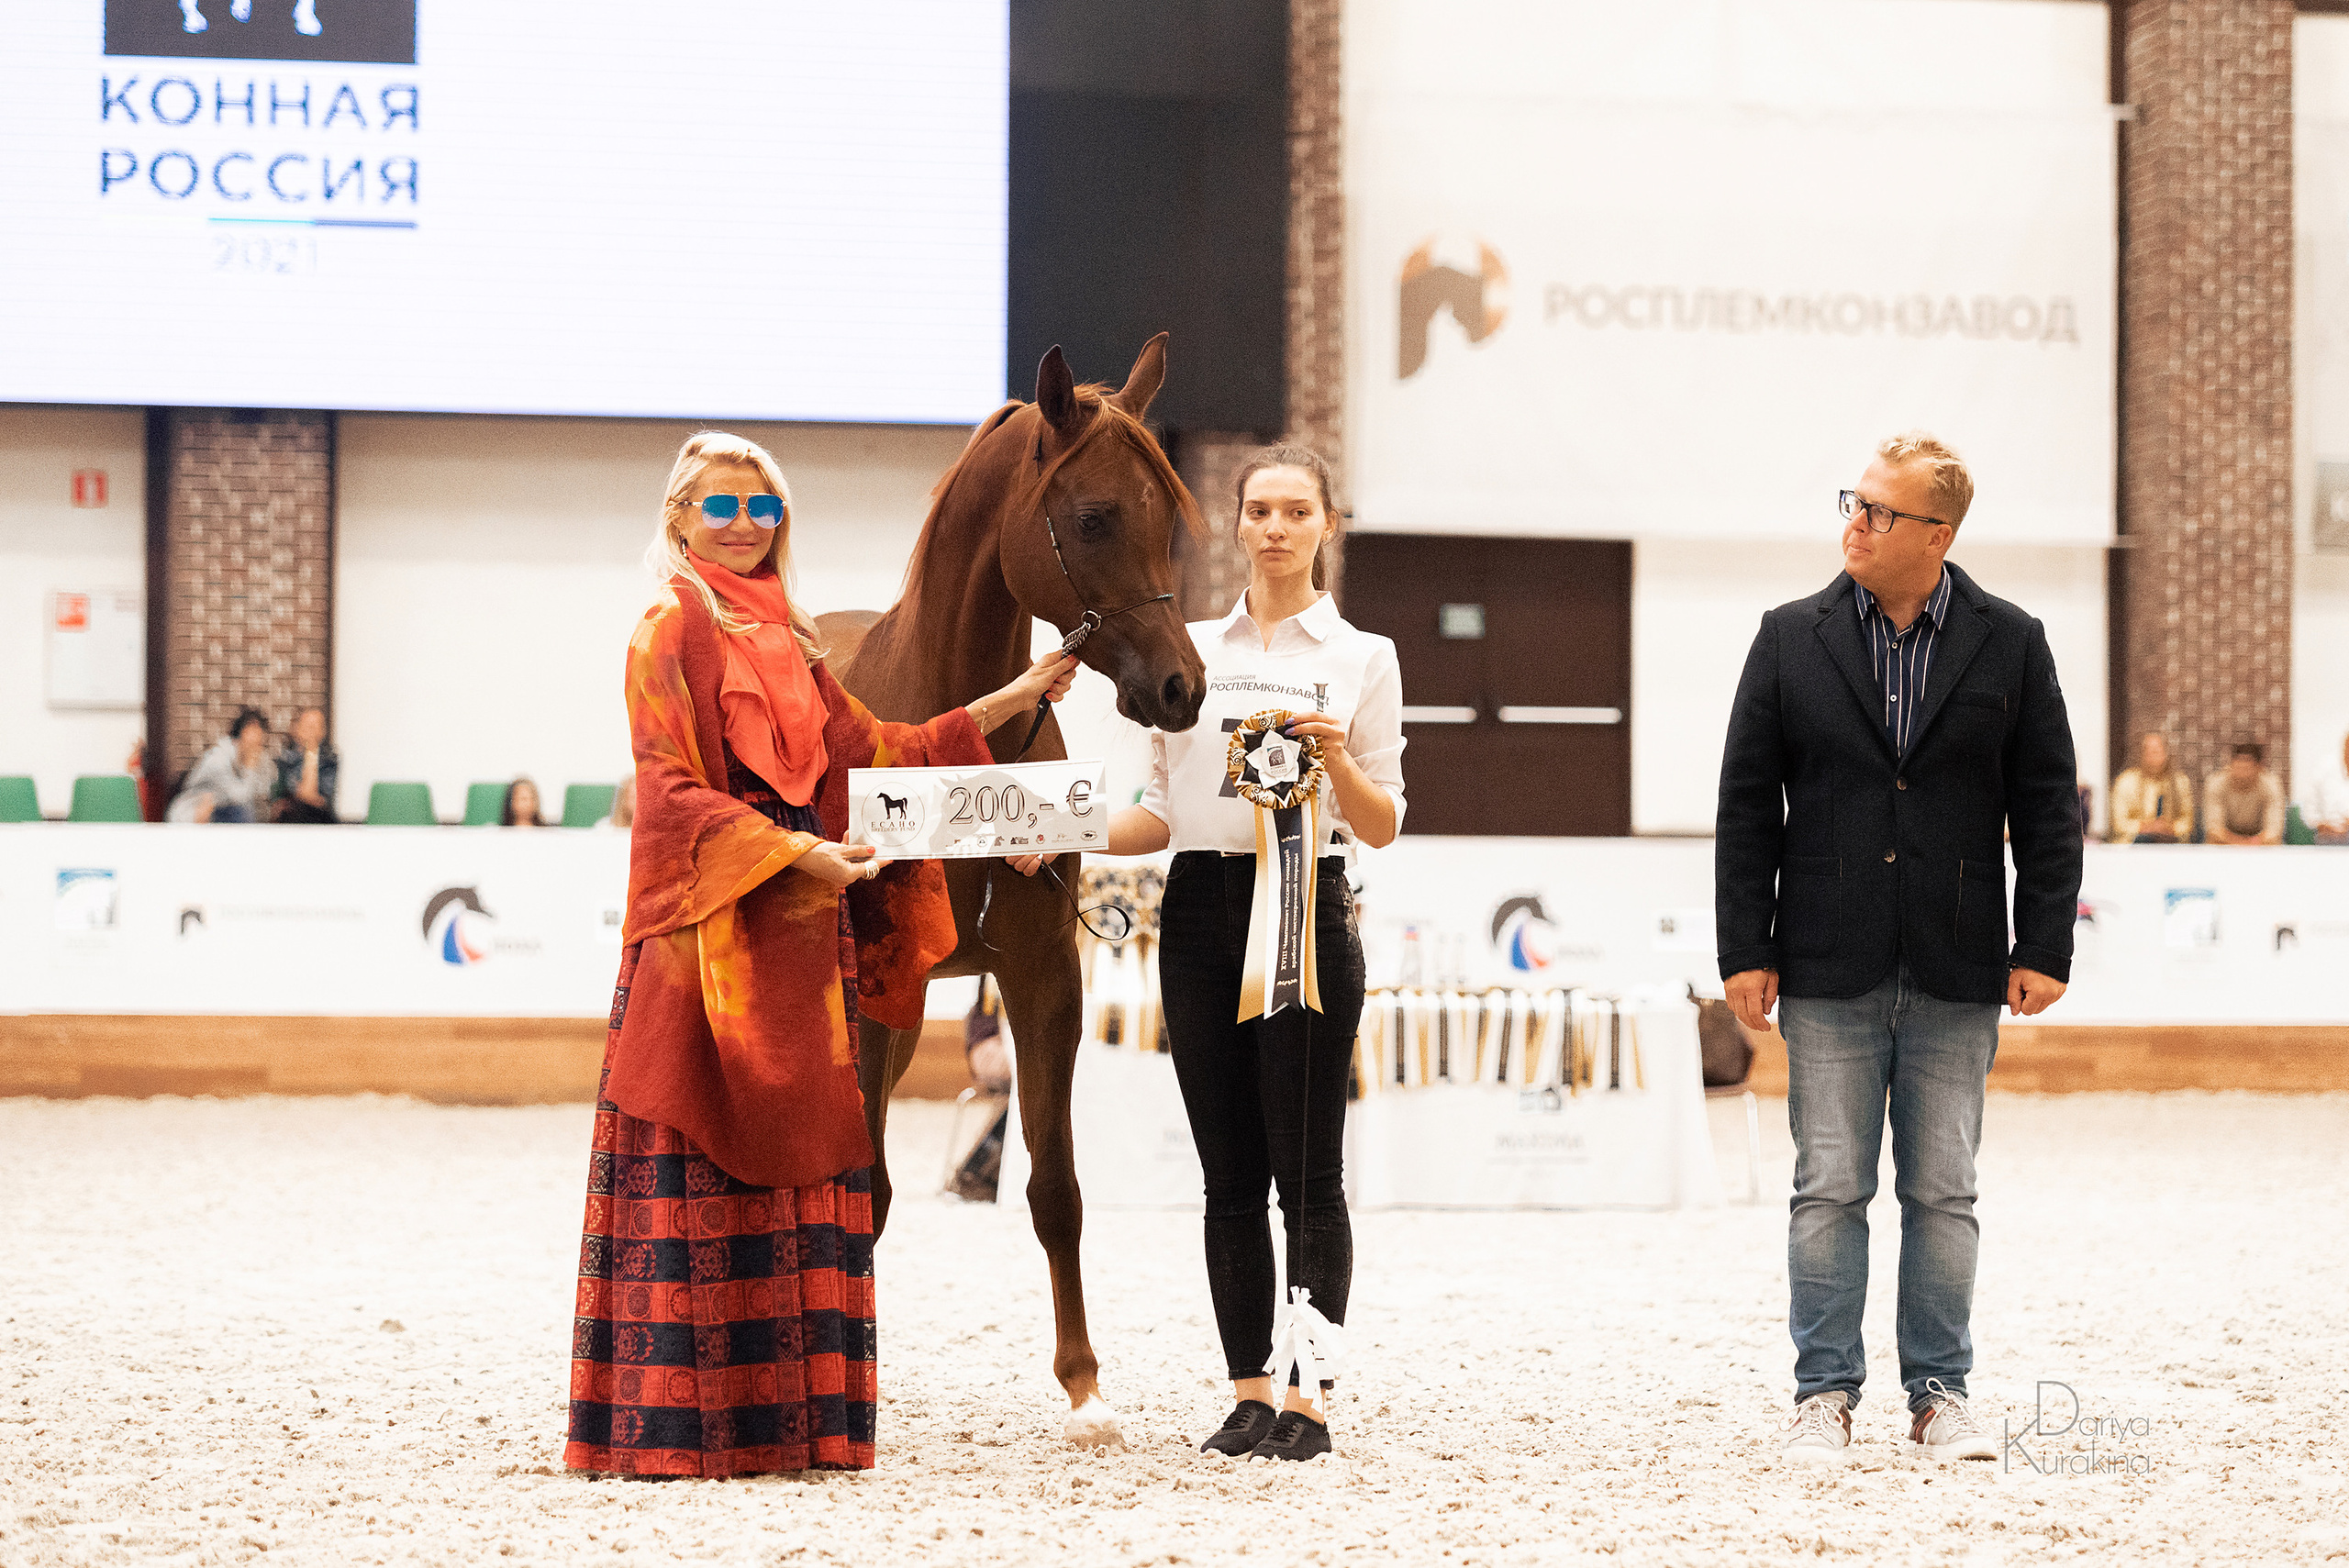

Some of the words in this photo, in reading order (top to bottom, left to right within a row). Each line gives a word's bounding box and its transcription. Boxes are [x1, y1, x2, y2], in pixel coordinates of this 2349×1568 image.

[100, 74, 420, 131] КОННАЯ
[100, 148, 420, 205] РОССИЯ
[211, 234, 318, 274] 2021
[1542, 283, 2081, 348] РОСПЛЕМКОНЗАВОД
[1065, 780, 1093, 818] €
[1282, 909, 1290, 950] Чемпионат
